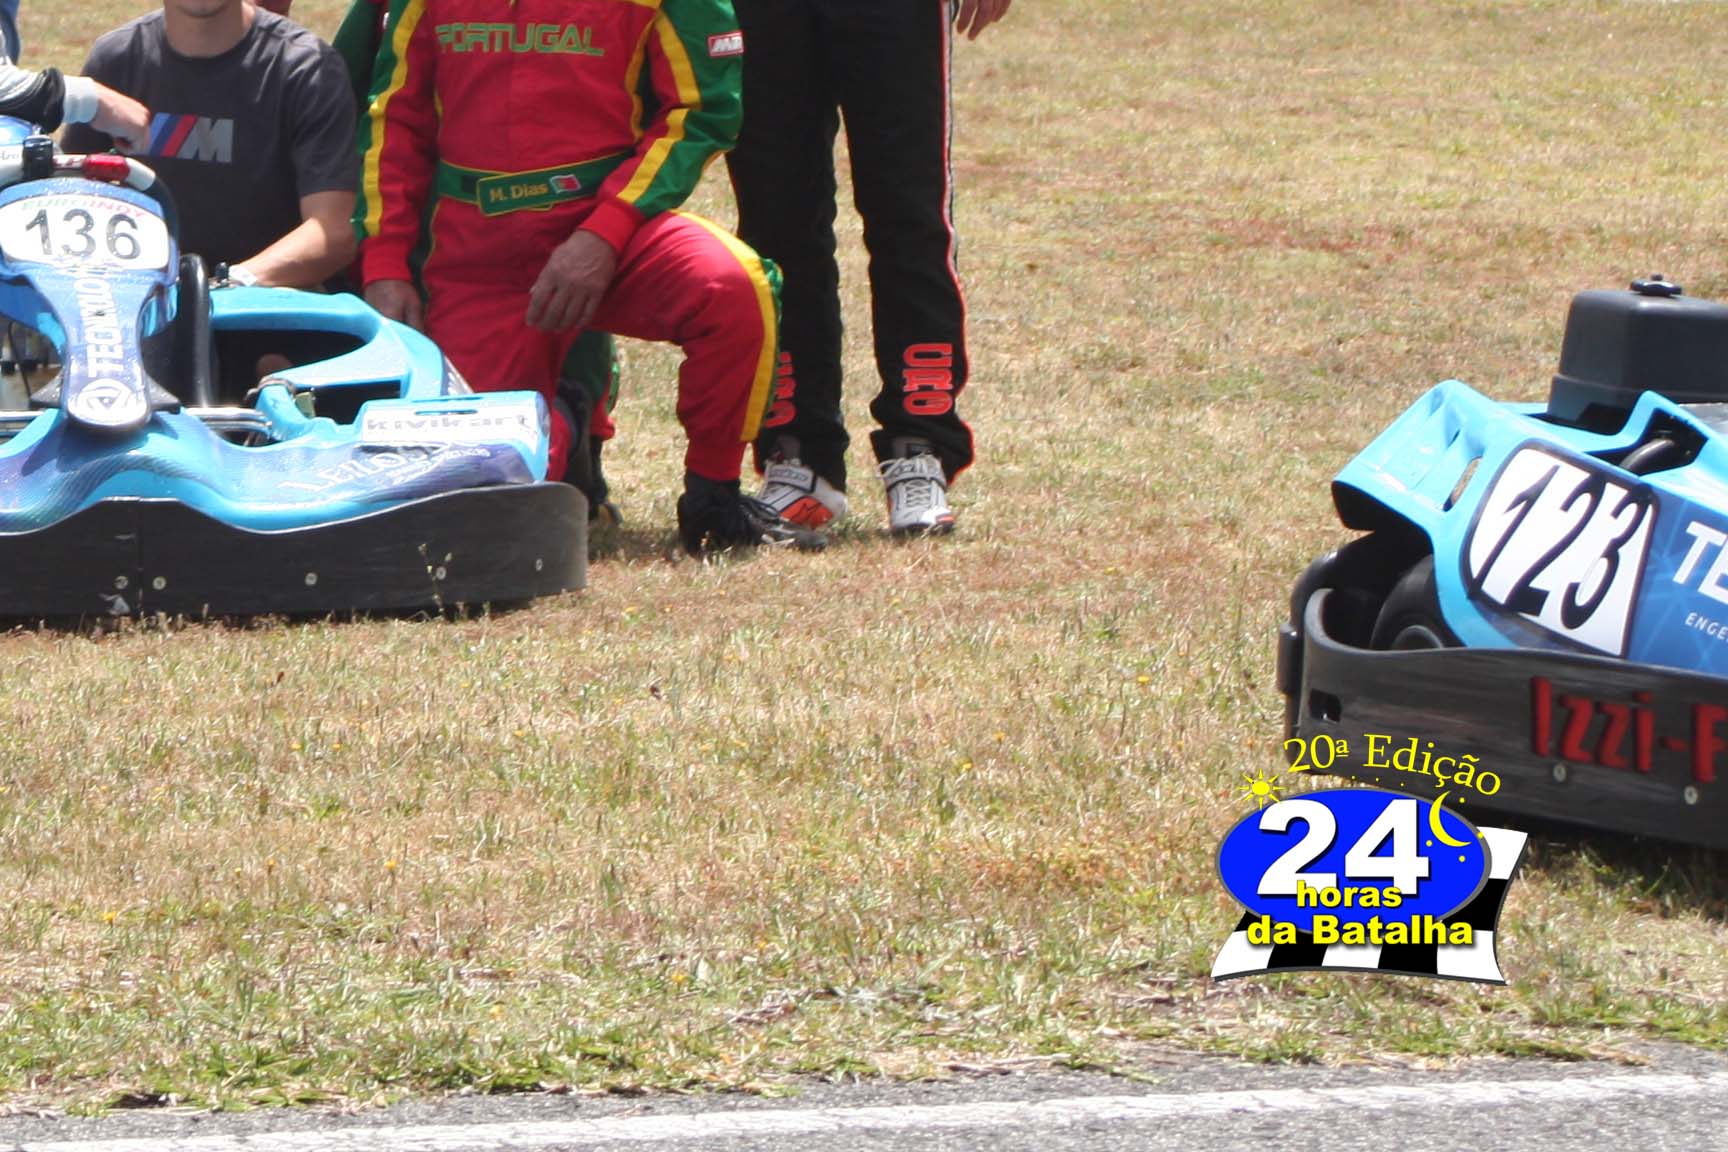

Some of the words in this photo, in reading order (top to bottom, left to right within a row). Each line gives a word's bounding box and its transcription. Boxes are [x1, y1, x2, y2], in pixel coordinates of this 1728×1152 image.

[435, 23, 605, 56] PORTUGAL
[489, 187, 509, 203] M.
[510, 183, 549, 200] Dias
[25, 208, 142, 260] 136
[1472, 465, 1651, 629] 123
